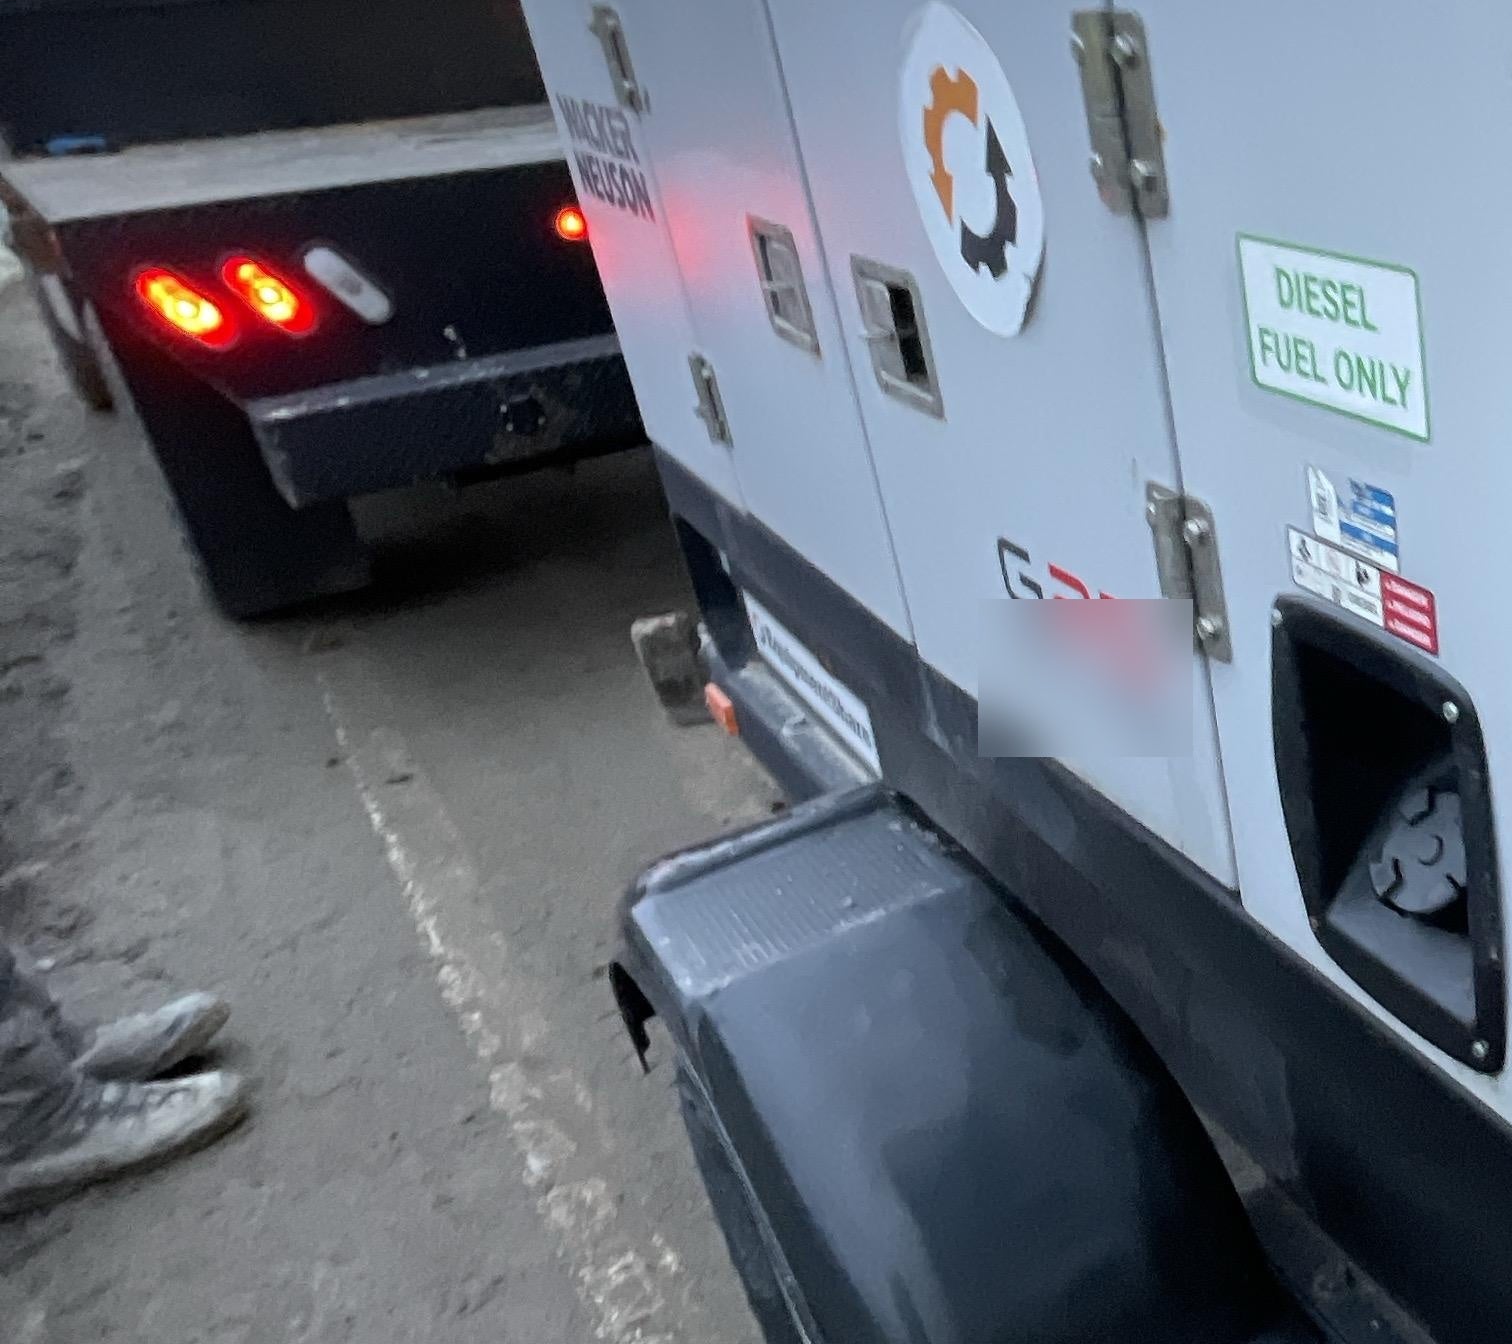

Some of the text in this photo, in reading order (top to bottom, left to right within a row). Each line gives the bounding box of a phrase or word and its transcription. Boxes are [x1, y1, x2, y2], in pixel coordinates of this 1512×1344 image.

[556, 93, 640, 165] WACKER
[573, 150, 656, 224] NEUSON
[1274, 264, 1380, 334] DIESEL
[1257, 324, 1411, 410] FUEL ONLY
